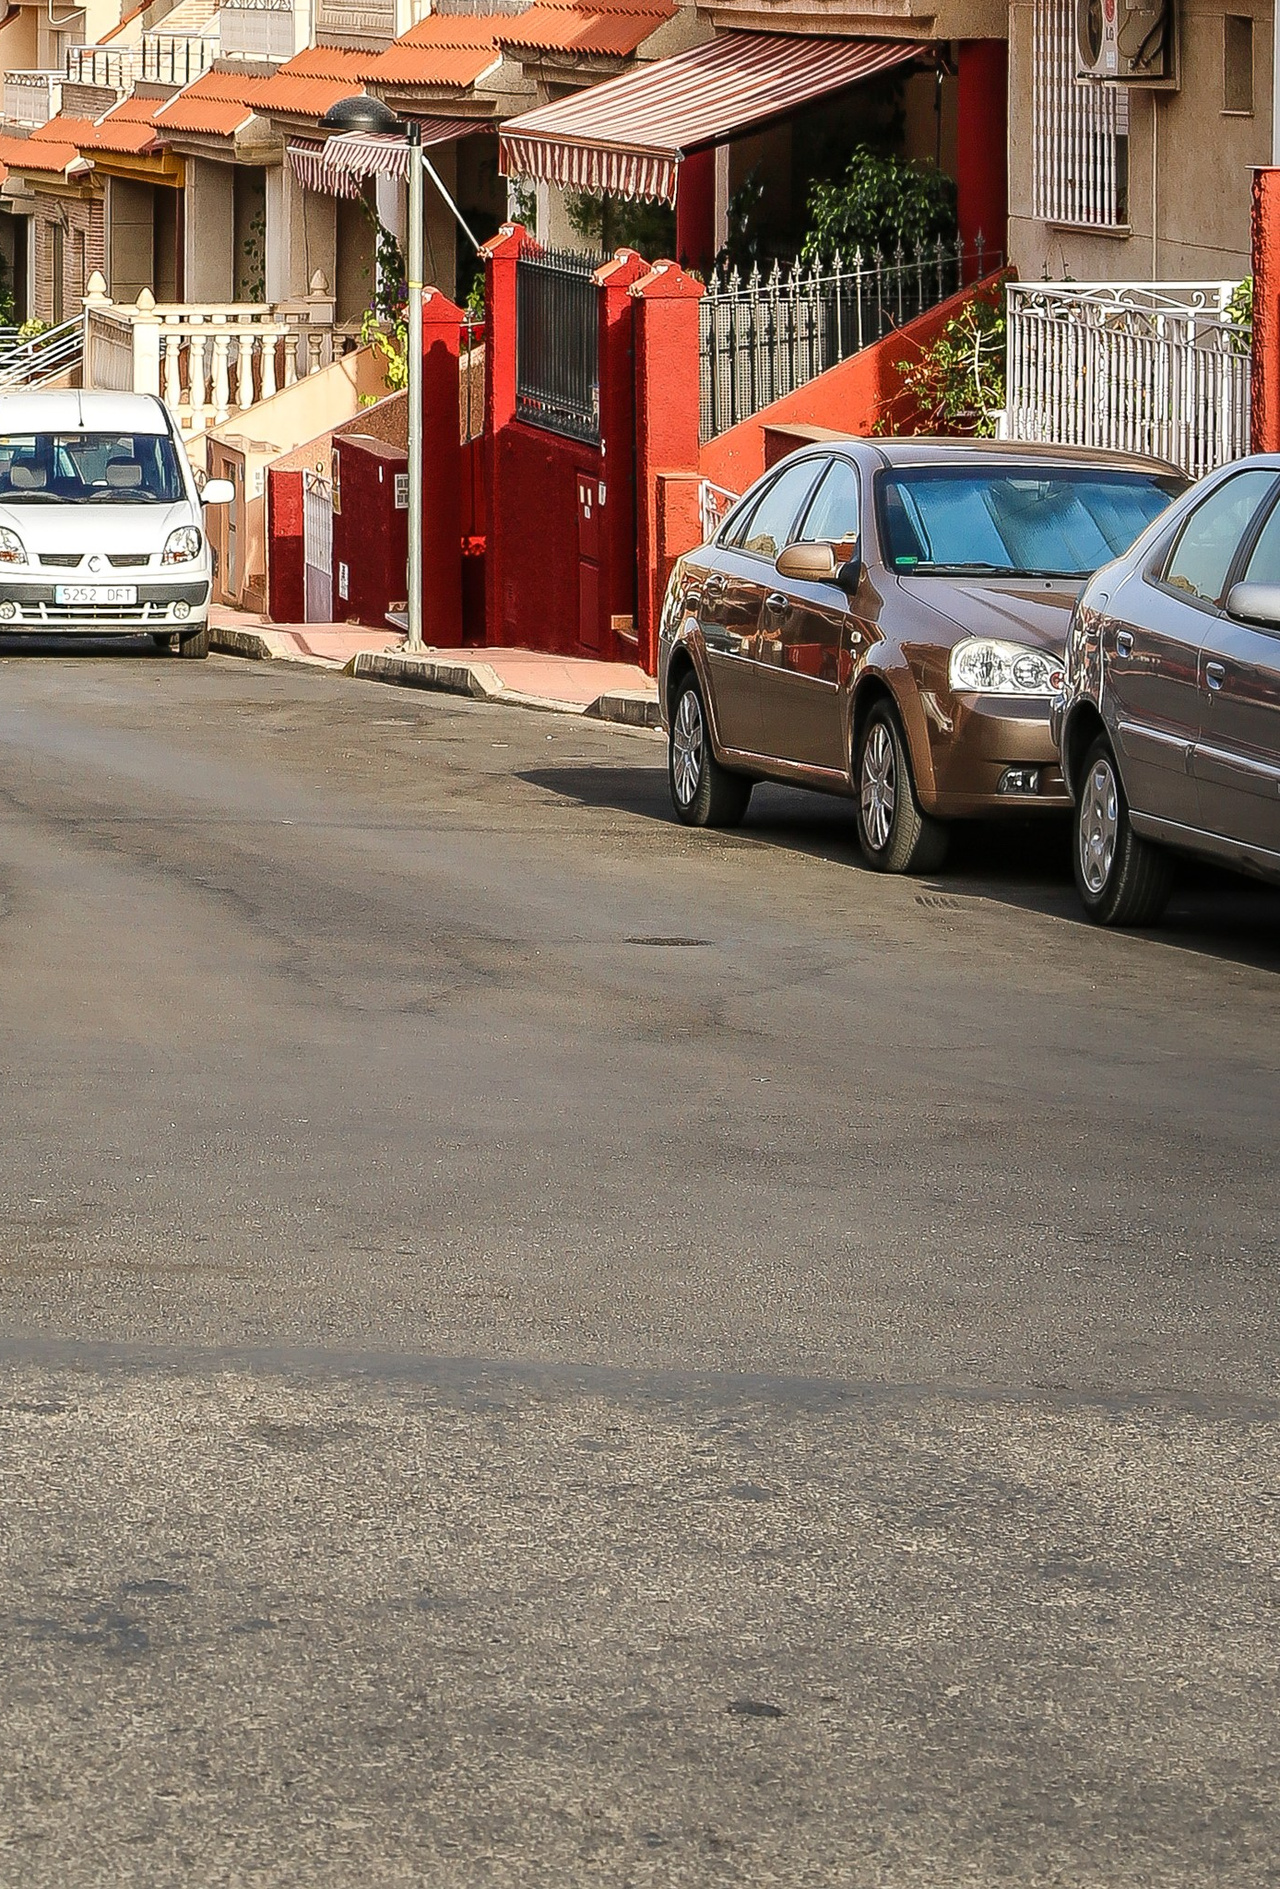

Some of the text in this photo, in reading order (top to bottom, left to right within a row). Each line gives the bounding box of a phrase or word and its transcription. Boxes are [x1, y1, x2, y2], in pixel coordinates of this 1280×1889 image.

[1106, 26, 1115, 42] LG
[63, 588, 131, 601] 5252 DFT
